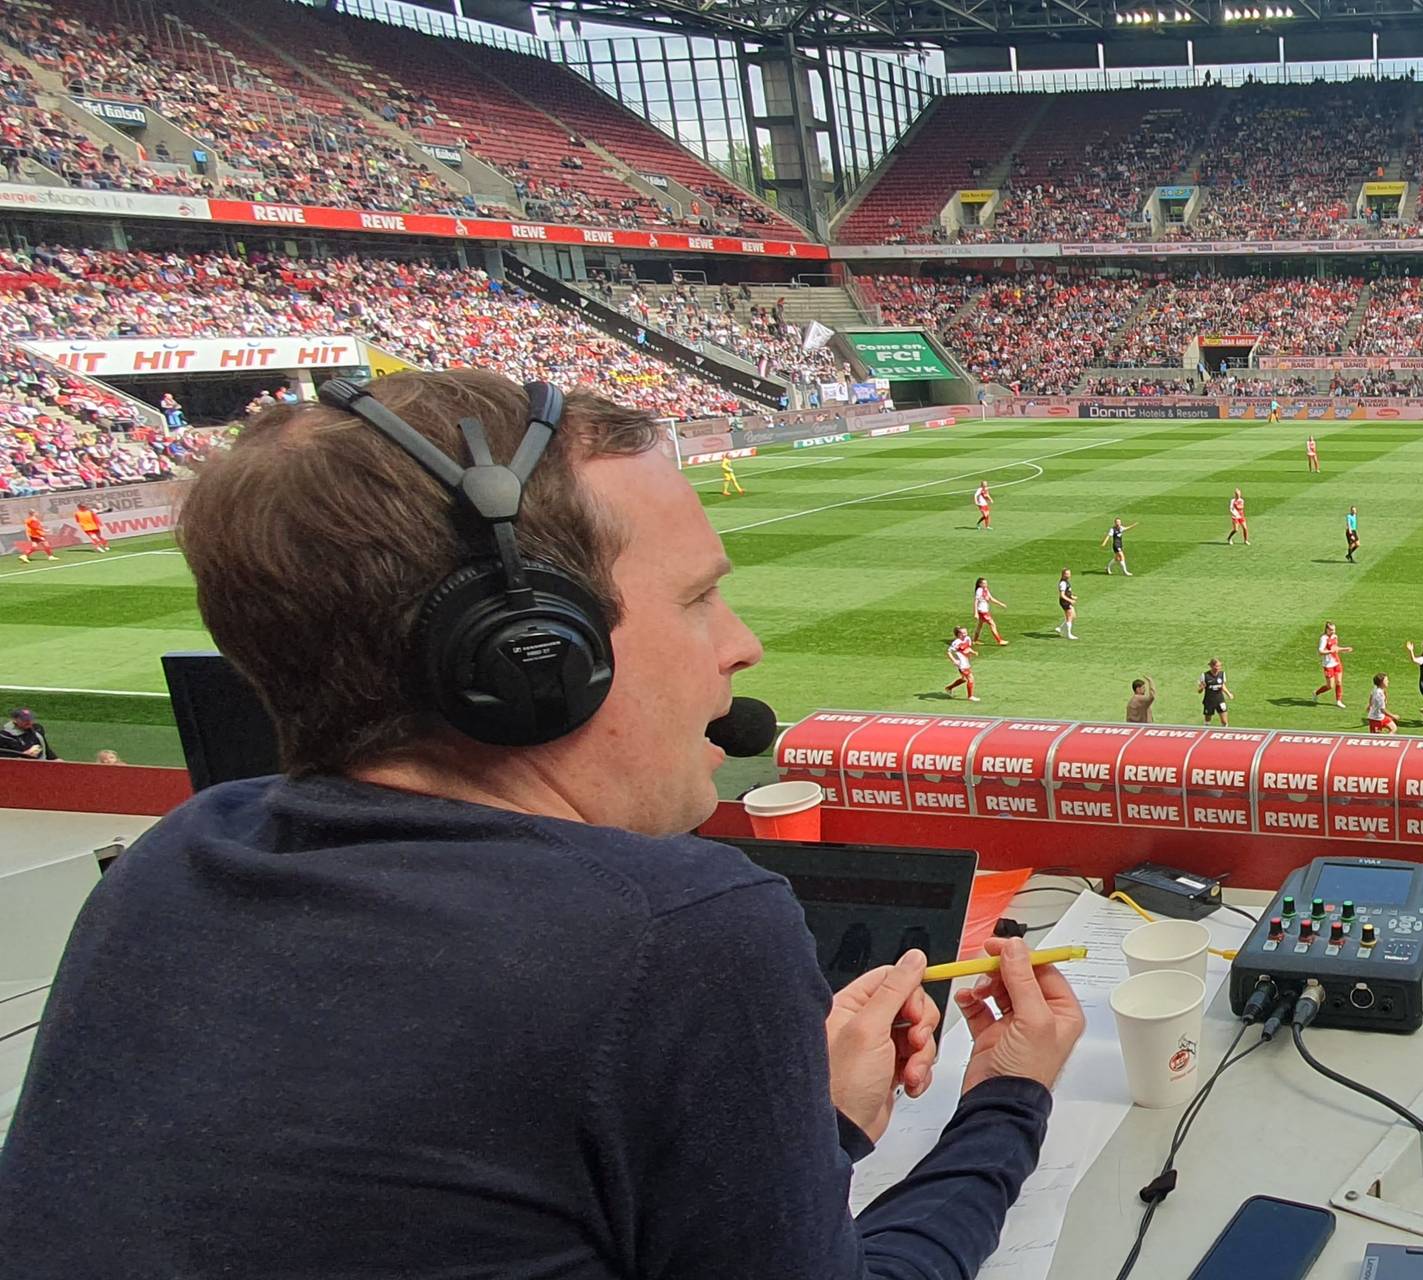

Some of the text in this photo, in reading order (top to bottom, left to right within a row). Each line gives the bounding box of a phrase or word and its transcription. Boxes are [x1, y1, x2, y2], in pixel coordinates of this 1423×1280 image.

[252, 205, 305, 223] REWE
[360, 213, 406, 231] REWE
[512, 225, 547, 239] REWE
[584, 230, 615, 244] REWE
[688, 237, 714, 250] REWE
[742, 241, 765, 253] REWE
[134, 350, 197, 370] HIT
[220, 348, 278, 367] HIT
[298, 346, 348, 364] HIT
[877, 351, 921, 362] FC!
[876, 366, 940, 374] DEVK
[1089, 406, 1208, 418] Dorint Hotels & Resorts
[1228, 408, 1246, 417] SAP
[1281, 408, 1298, 417] SAP
[1307, 408, 1325, 417] SAP
[1334, 408, 1352, 417] SAP
[801, 434, 847, 447] DEVK
[814, 713, 867, 723] REWE
[877, 716, 930, 726] REWE
[940, 719, 991, 729] REWE
[1008, 722, 1060, 732] REWE
[1081, 725, 1134, 735] REWE
[1145, 728, 1198, 739] REWE
[1209, 731, 1264, 742] REWE
[1279, 735, 1334, 745] REWE
[1346, 738, 1401, 748] REWE
[783, 748, 833, 765] REWE
[847, 751, 898, 768] REWE
[911, 754, 963, 771] REWE
[981, 757, 1033, 774] REWE
[1058, 762, 1110, 780] REWE
[1123, 765, 1177, 783] REWE
[1191, 769, 1246, 787] REWE
[1263, 772, 1319, 791] REWE
[1333, 776, 1389, 794] REWE
[852, 788, 903, 806] REWE
[915, 791, 966, 809] REWE
[986, 795, 1037, 813] REWE
[1060, 799, 1112, 817] REWE
[1127, 803, 1180, 821] REWE
[1194, 806, 1248, 825] REWE
[1264, 811, 1320, 829] REWE
[1334, 814, 1390, 833] REWE
